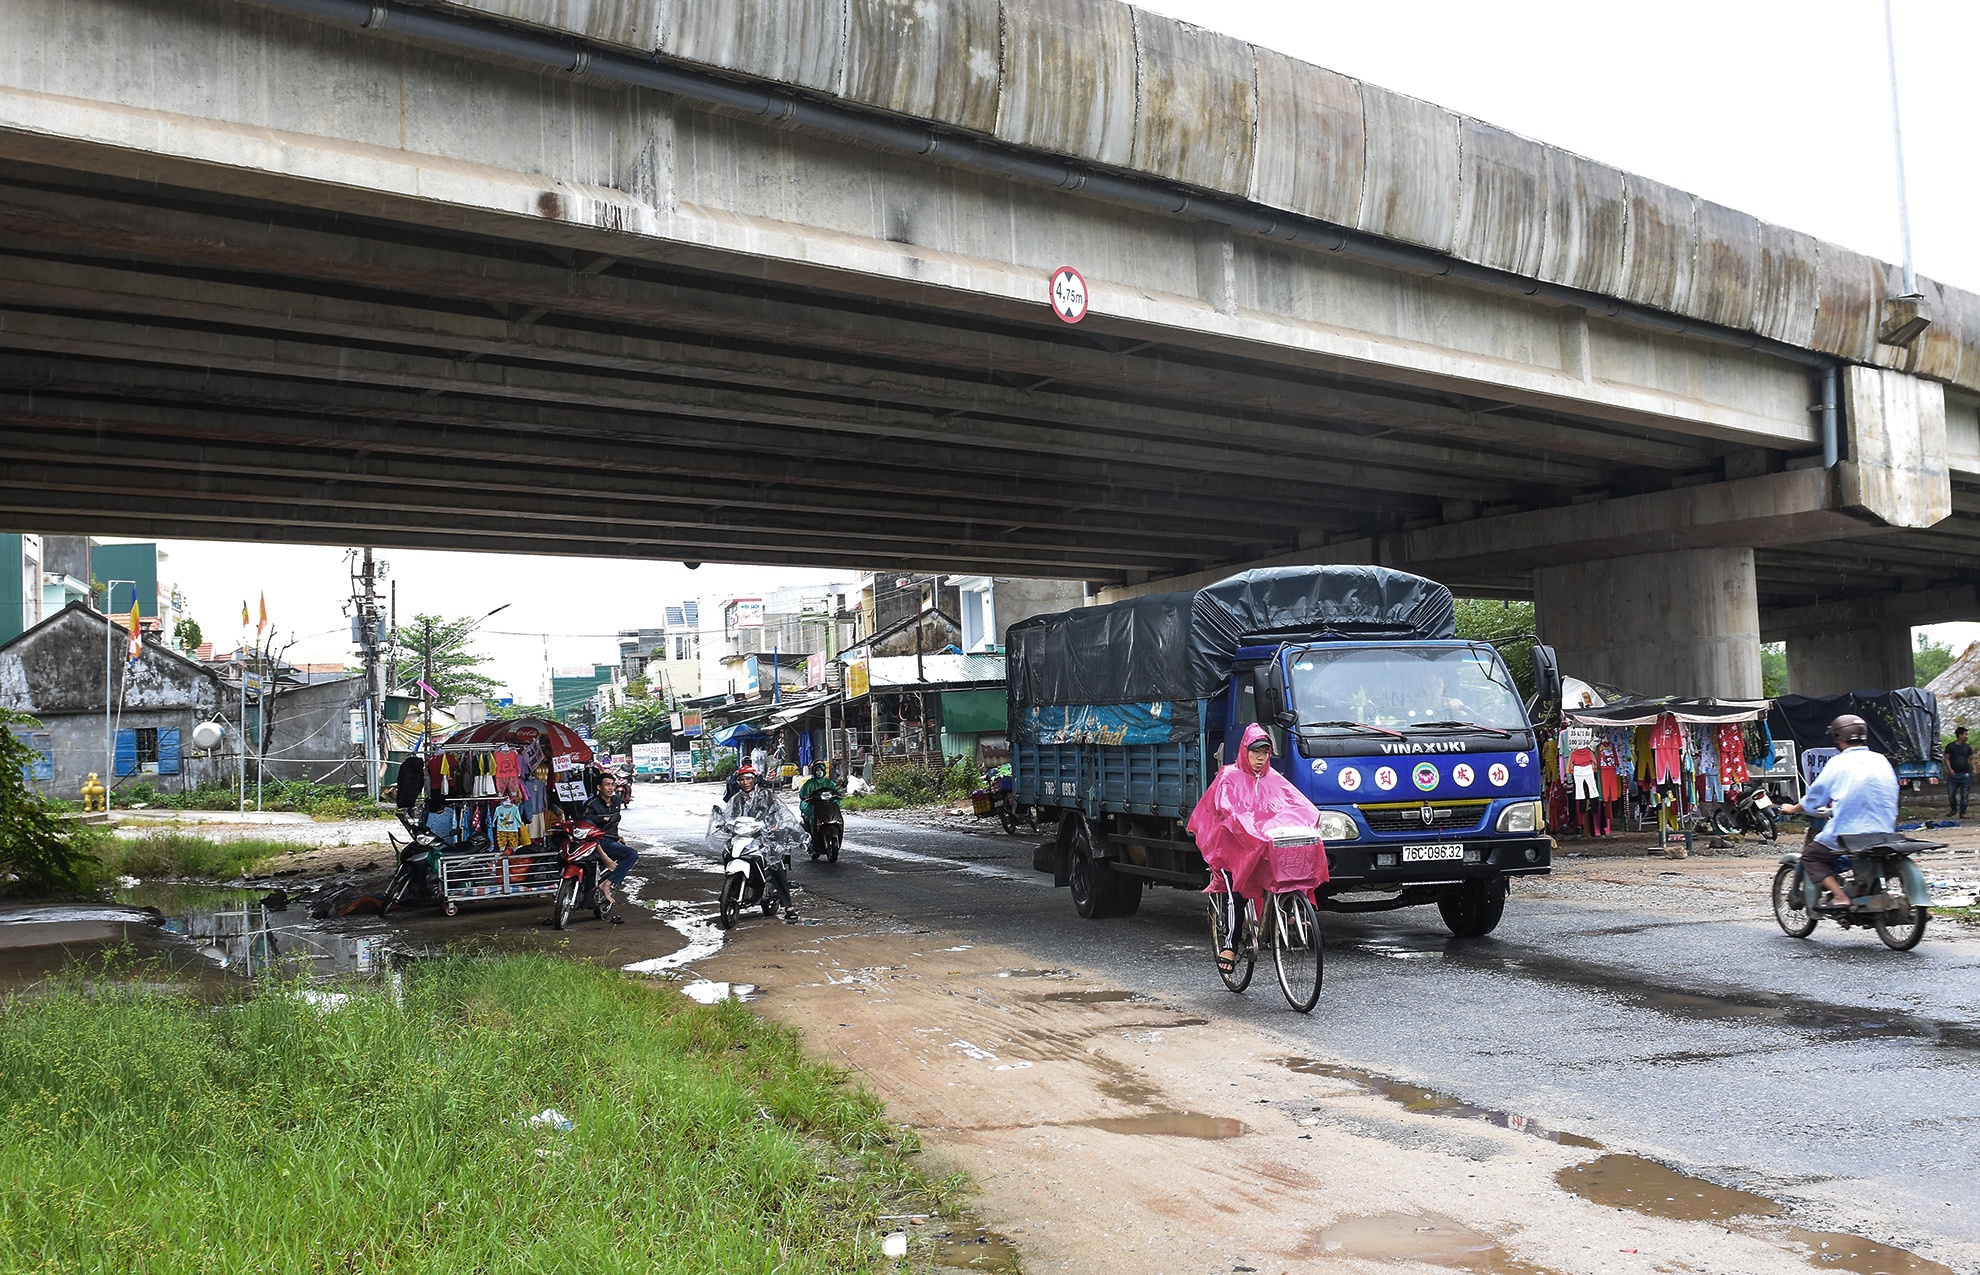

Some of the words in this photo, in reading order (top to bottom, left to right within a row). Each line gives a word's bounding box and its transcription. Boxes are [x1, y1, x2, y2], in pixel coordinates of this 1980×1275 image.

[1056, 282, 1083, 304] 4,75m
[1380, 741, 1466, 754] VINAXUKI
[1343, 771, 1355, 786] 馬
[1380, 770, 1391, 785] 到
[1457, 767, 1470, 782] 成
[1492, 767, 1504, 782] 功
